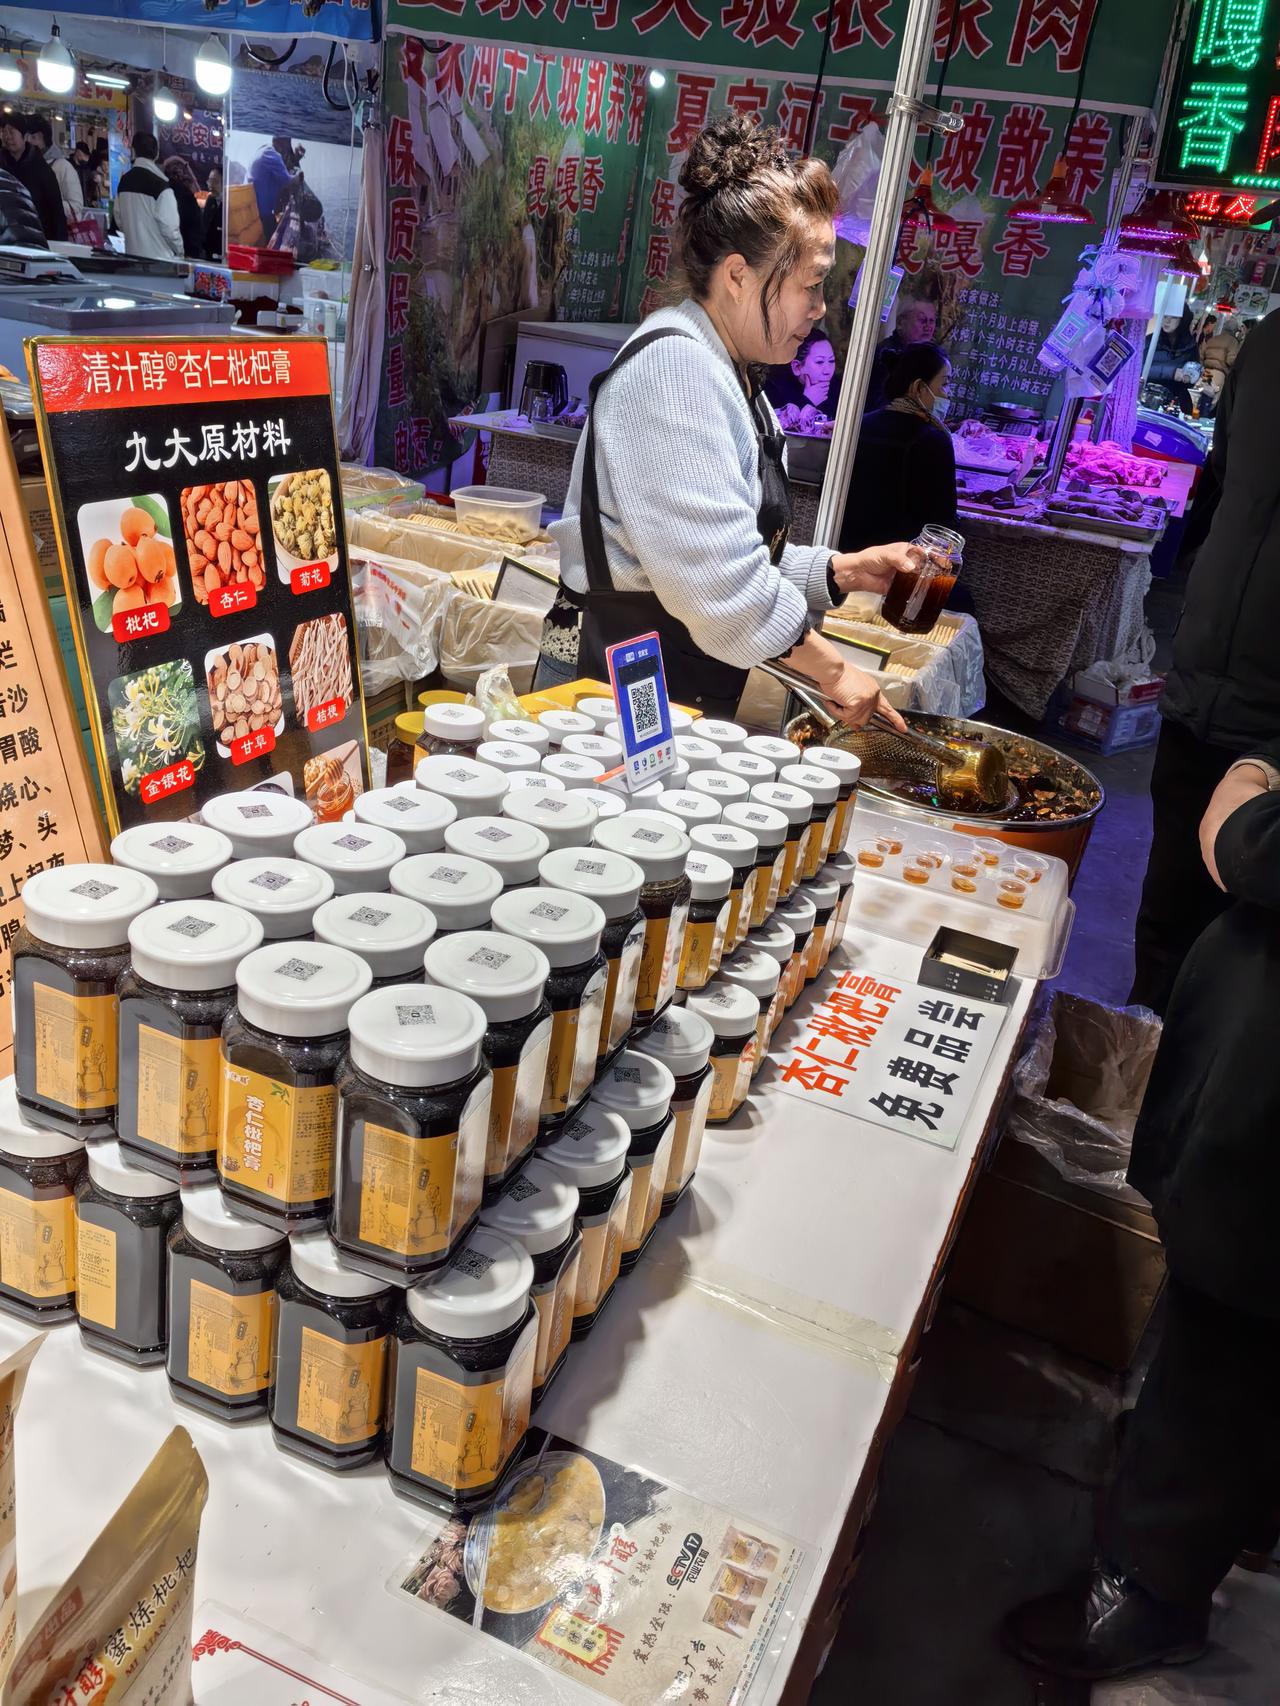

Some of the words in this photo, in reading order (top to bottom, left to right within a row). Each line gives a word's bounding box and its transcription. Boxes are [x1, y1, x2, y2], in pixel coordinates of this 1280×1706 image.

[527, 155, 605, 219] 嘎嘎香
[124, 418, 292, 472] 九大原材料
[298, 568, 324, 587] 菊花
[219, 589, 248, 610] 杏仁
[124, 611, 160, 634] 枇杷
[315, 705, 339, 724] 桔梗
[240, 735, 268, 752] 甘草
[145, 765, 193, 797] 金银花
[776, 970, 903, 1097] 杏仁枇杷膏
[868, 999, 986, 1131] 免费品尝
